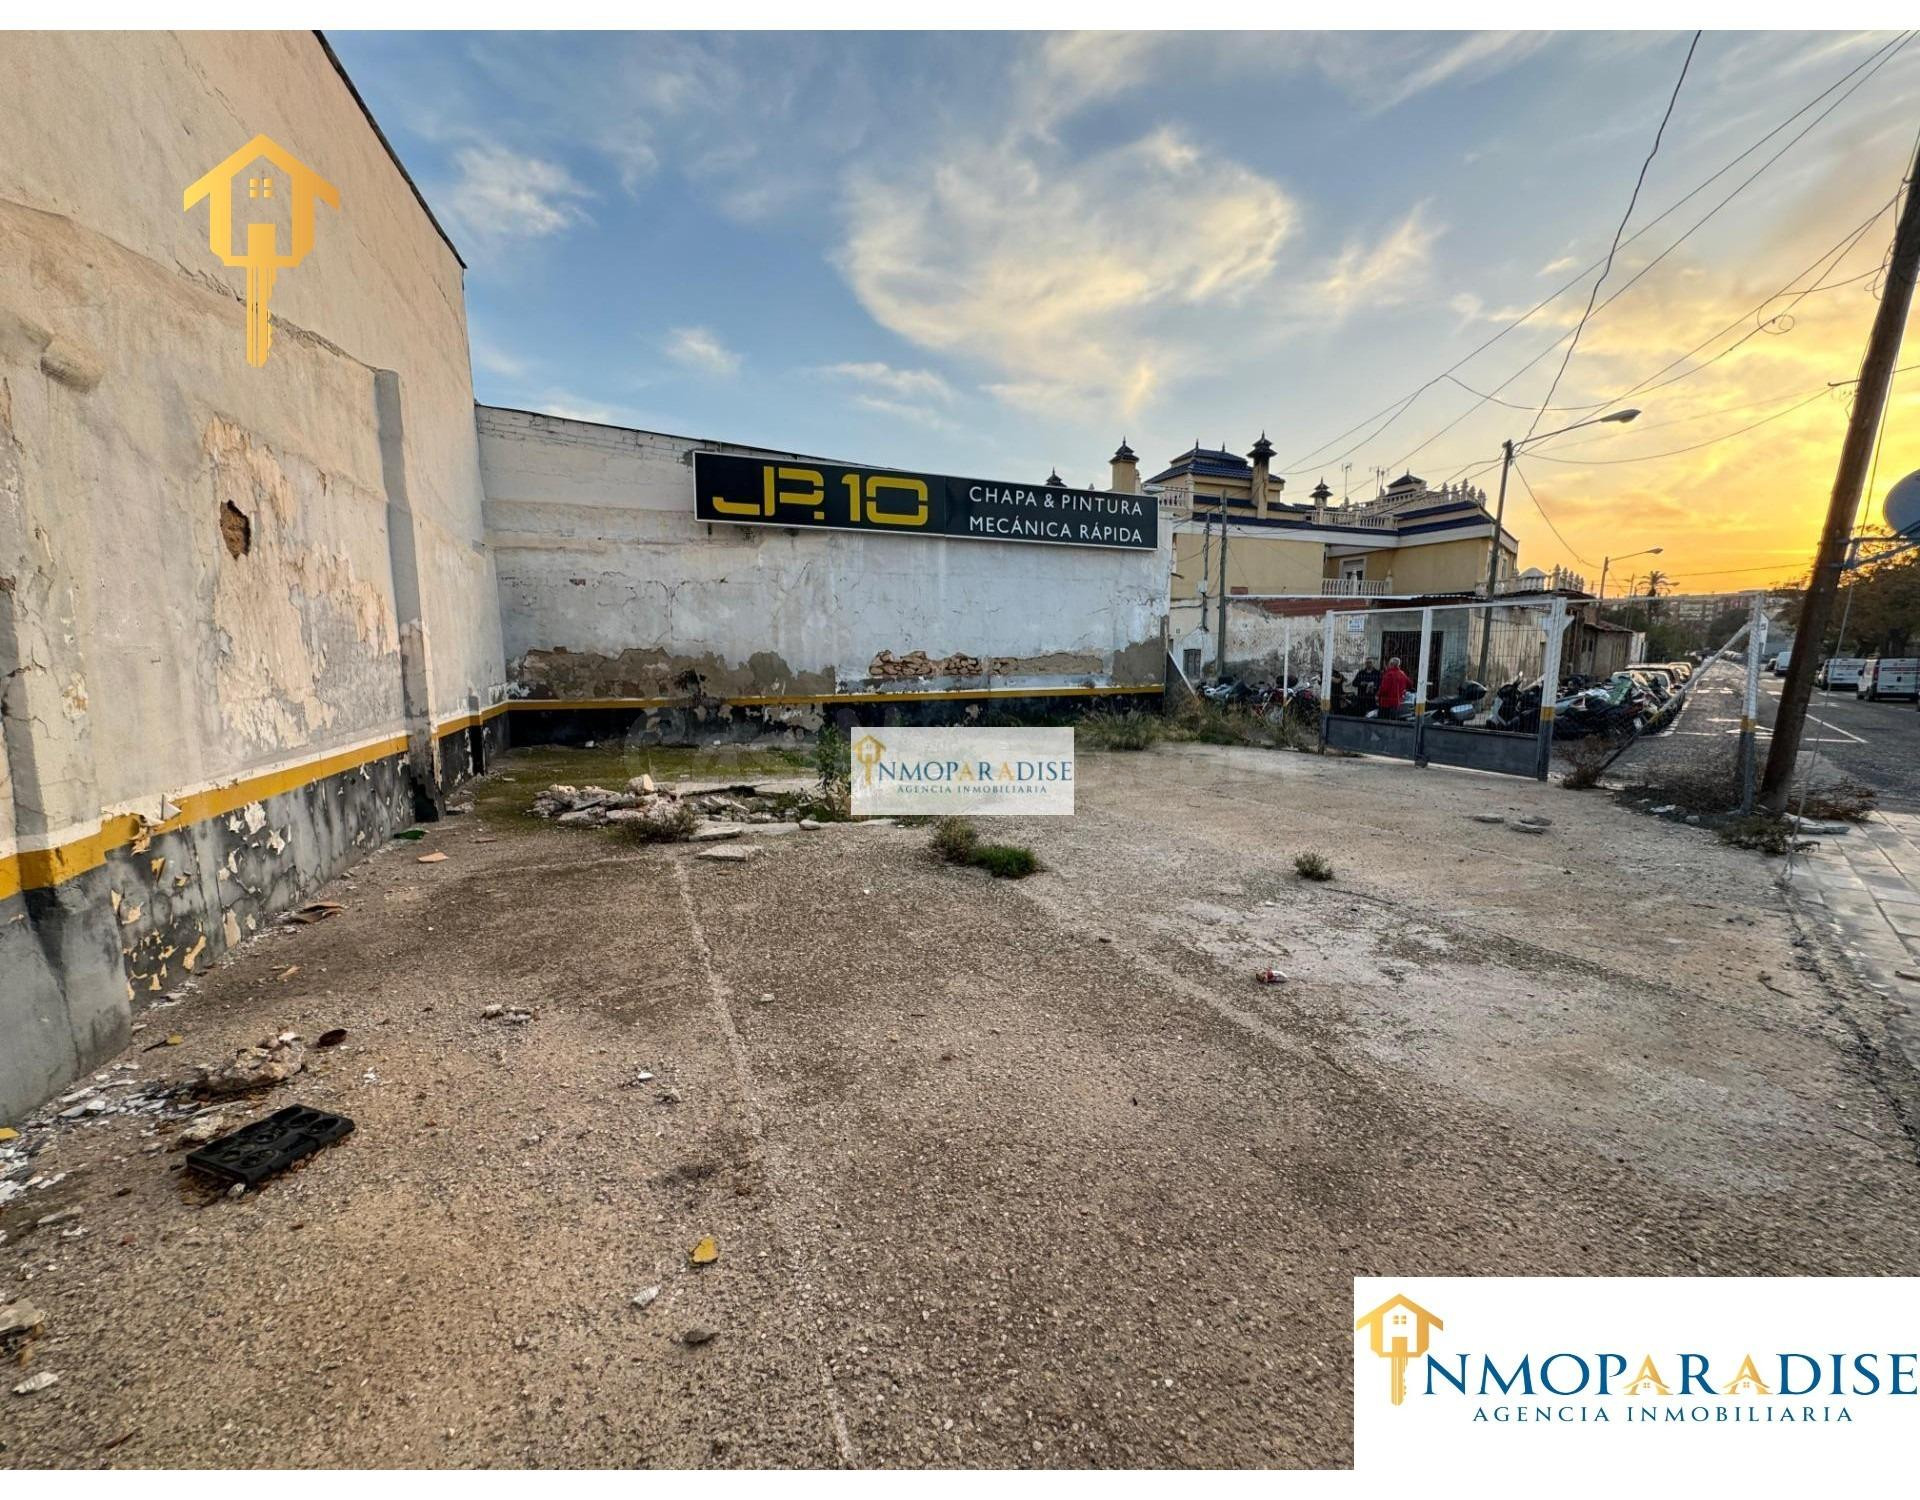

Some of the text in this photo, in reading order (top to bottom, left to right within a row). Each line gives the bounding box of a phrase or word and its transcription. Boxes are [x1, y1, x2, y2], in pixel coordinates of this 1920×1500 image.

[969, 486, 1143, 516] CHAPA & PINTURA
[969, 515, 1143, 543] MECÁNICA RÁPIDA
